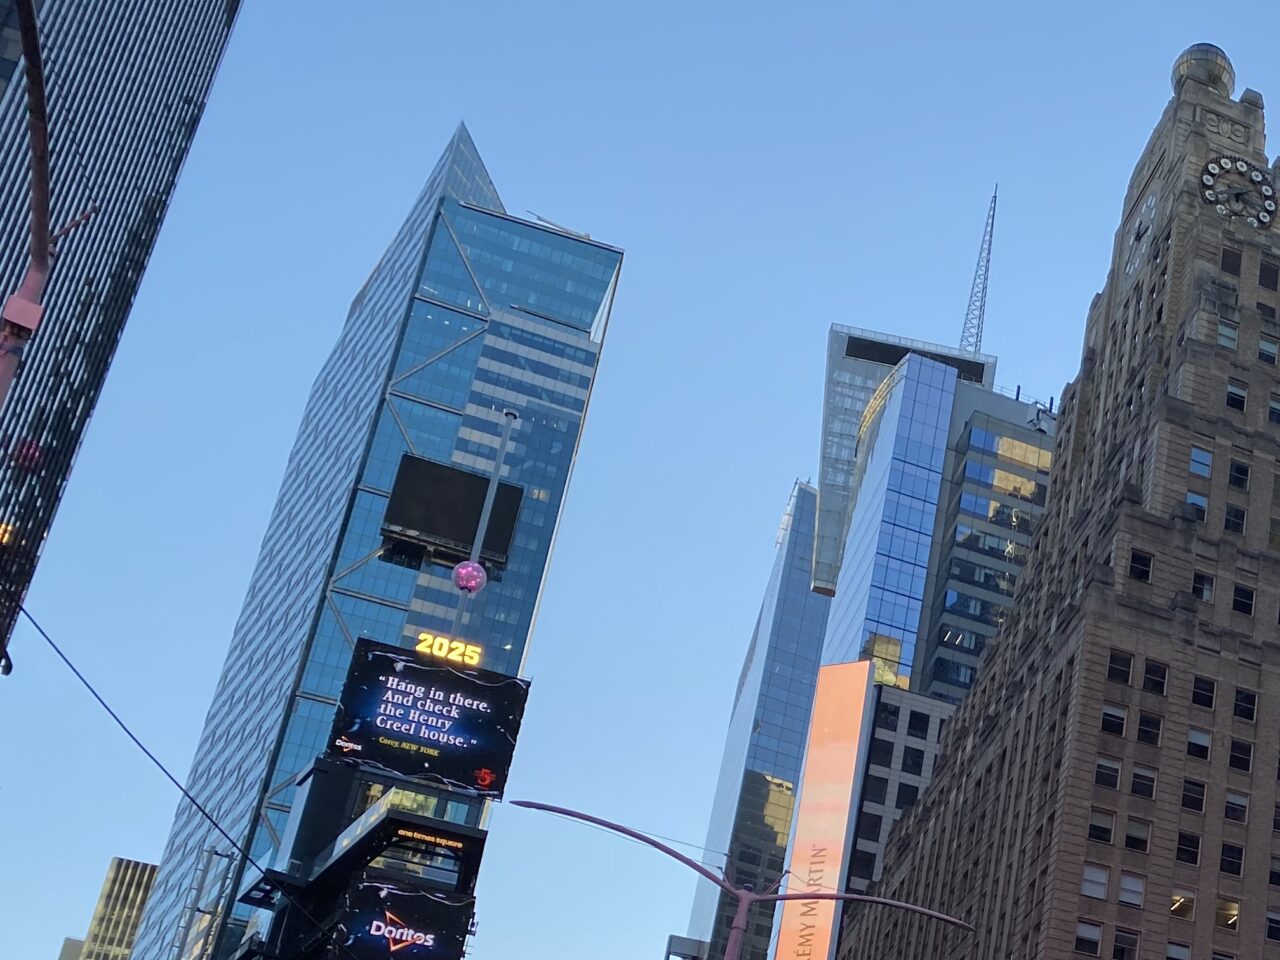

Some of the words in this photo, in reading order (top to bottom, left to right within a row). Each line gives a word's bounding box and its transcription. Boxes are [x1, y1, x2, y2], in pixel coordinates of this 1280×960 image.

[415, 632, 482, 665] 2025
[383, 690, 412, 707] And
[417, 699, 460, 718] check
[430, 687, 444, 700] in
[450, 693, 490, 713] there.
[376, 715, 415, 735] Creel
[379, 703, 404, 718] the
[408, 710, 452, 731] Henry
[401, 741, 418, 751] NEW
[420, 745, 440, 757] YORK
[398, 828, 413, 838] one
[414, 832, 435, 843] times
[436, 835, 463, 848] square
[370, 920, 435, 947] Doritos
